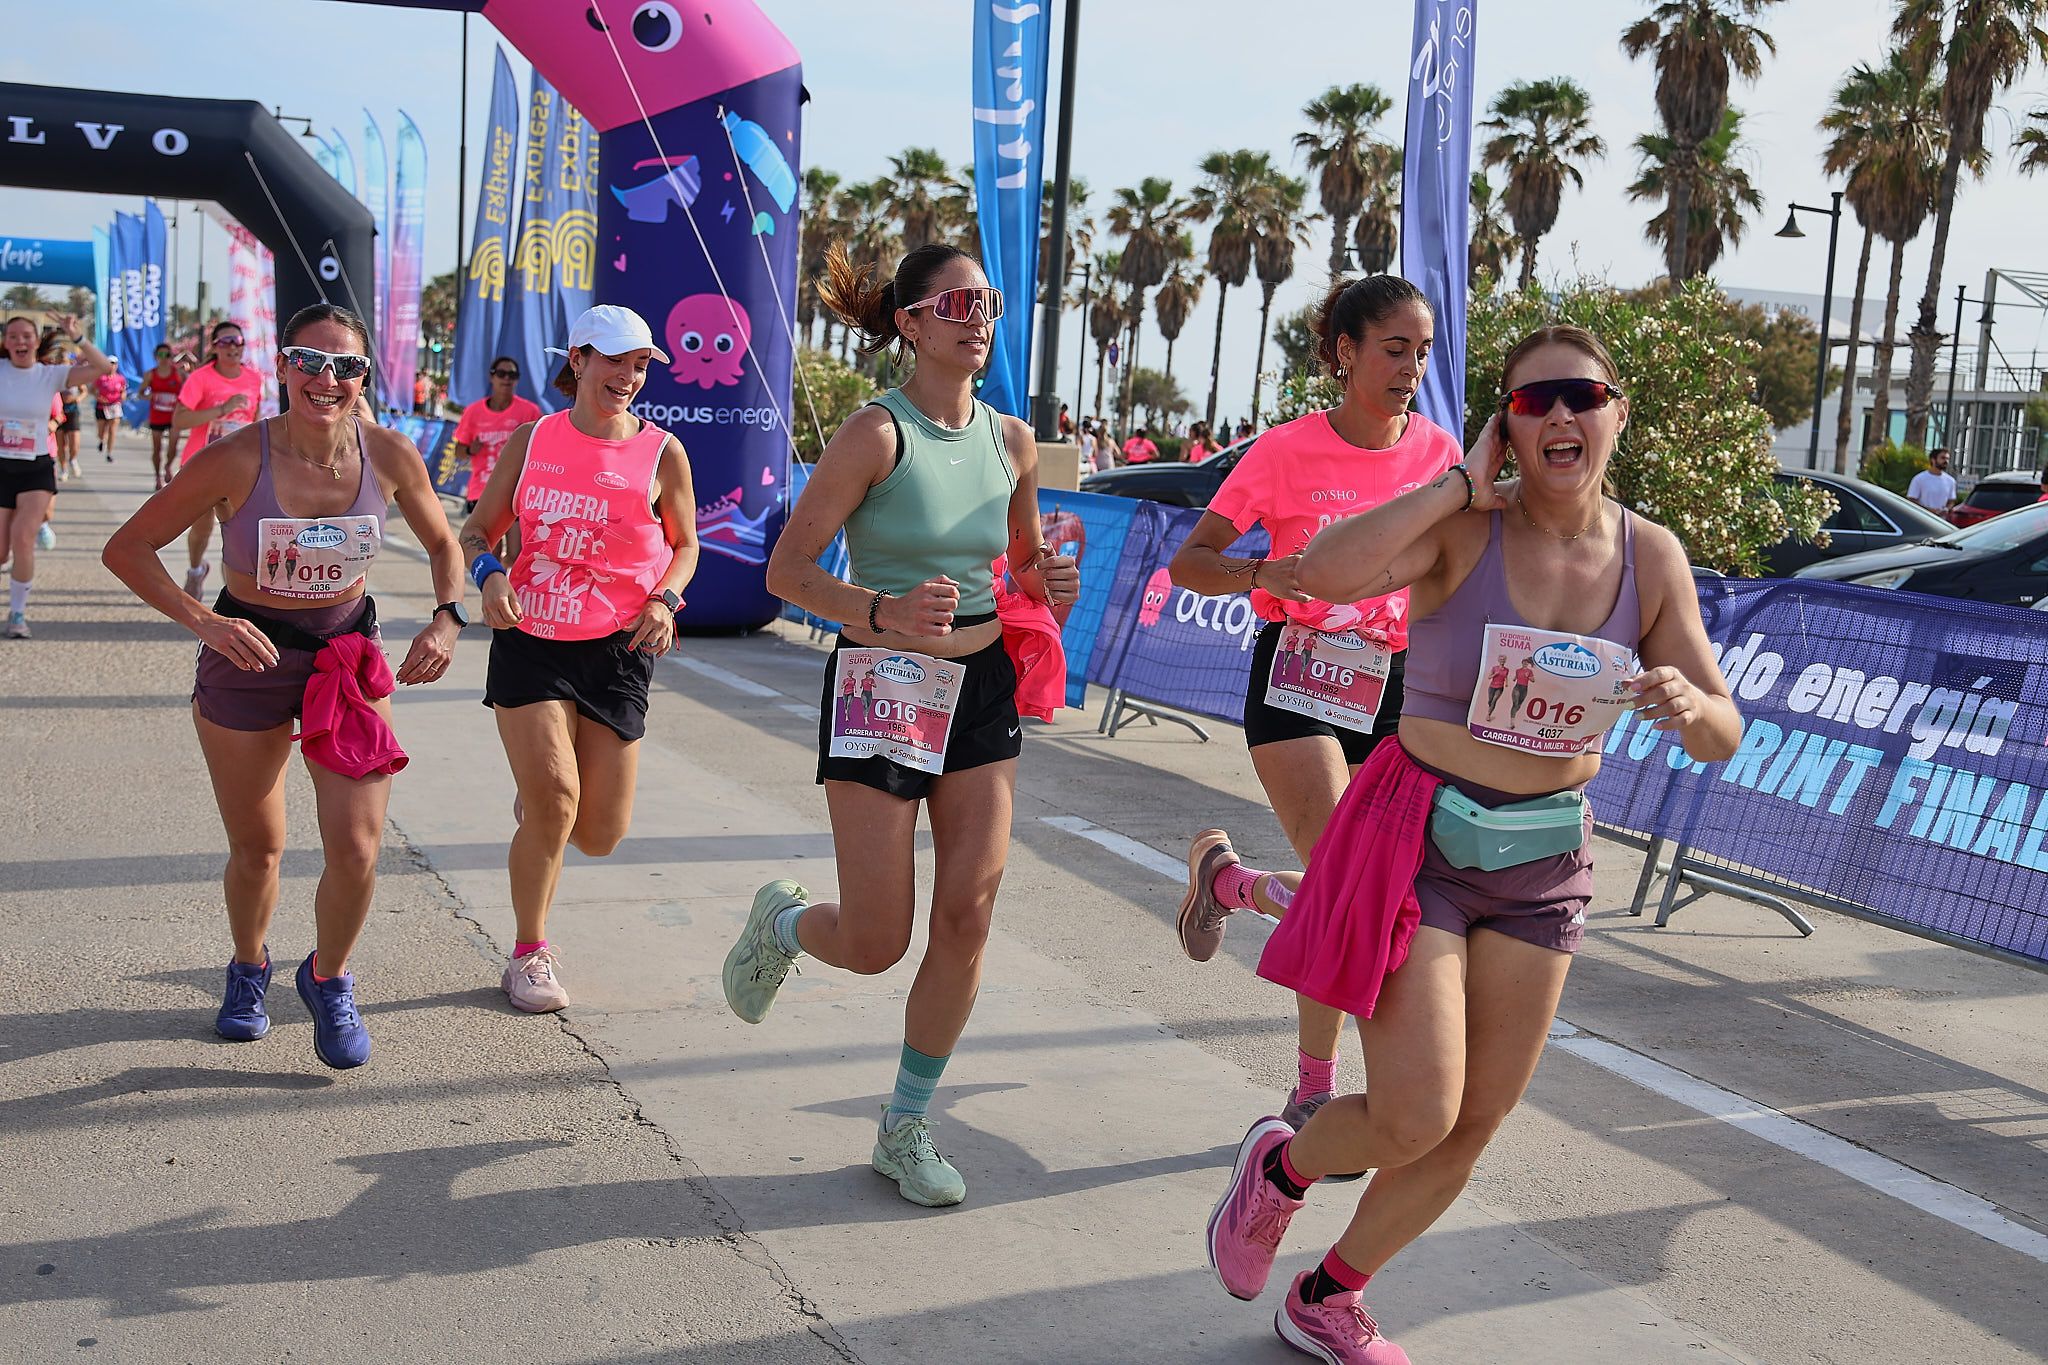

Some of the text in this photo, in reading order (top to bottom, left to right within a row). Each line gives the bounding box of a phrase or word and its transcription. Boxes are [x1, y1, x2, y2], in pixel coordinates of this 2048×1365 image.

[715, 407, 781, 432] energy
[528, 460, 565, 475] OYSHO
[1311, 489, 1357, 503] OYSHO
[300, 534, 343, 544] ASTURIANA
[557, 526, 593, 561] DE
[298, 564, 342, 581] 016
[269, 589, 296, 599] CARRERA
[309, 583, 331, 592] 4036
[518, 585, 583, 625] MUJER
[531, 622, 556, 638] 2026
[1500, 638, 1532, 651] SUMA
[1538, 651, 1597, 673] ASTURIANA
[878, 663, 921, 681] ASTURIANA
[1311, 661, 1355, 686] 016
[1280, 682, 1306, 694] CARRERA
[1306, 688, 1315, 697] DE
[1314, 691, 1321, 699] LA
[1322, 693, 1341, 704] MUJER
[1345, 700, 1367, 713] VALENCIA
[1320, 683, 1340, 695] 1962
[1278, 693, 1314, 710] OYSHO
[875, 699, 917, 723] 016
[1333, 711, 1364, 726] Santander
[1526, 697, 1586, 725] 016
[1787, 661, 2020, 760] energía
[844, 728, 873, 737] CARRERA
[874, 730, 883, 738] DE
[888, 722, 906, 734] 1963
[1537, 727, 1564, 739] 4037
[1482, 730, 1518, 744] CARRERA
[1519, 737, 1530, 747] DE
[1532, 739, 1542, 750] LA
[1543, 742, 1565, 751] MUJER
[1873, 755, 2048, 874] FINAL
